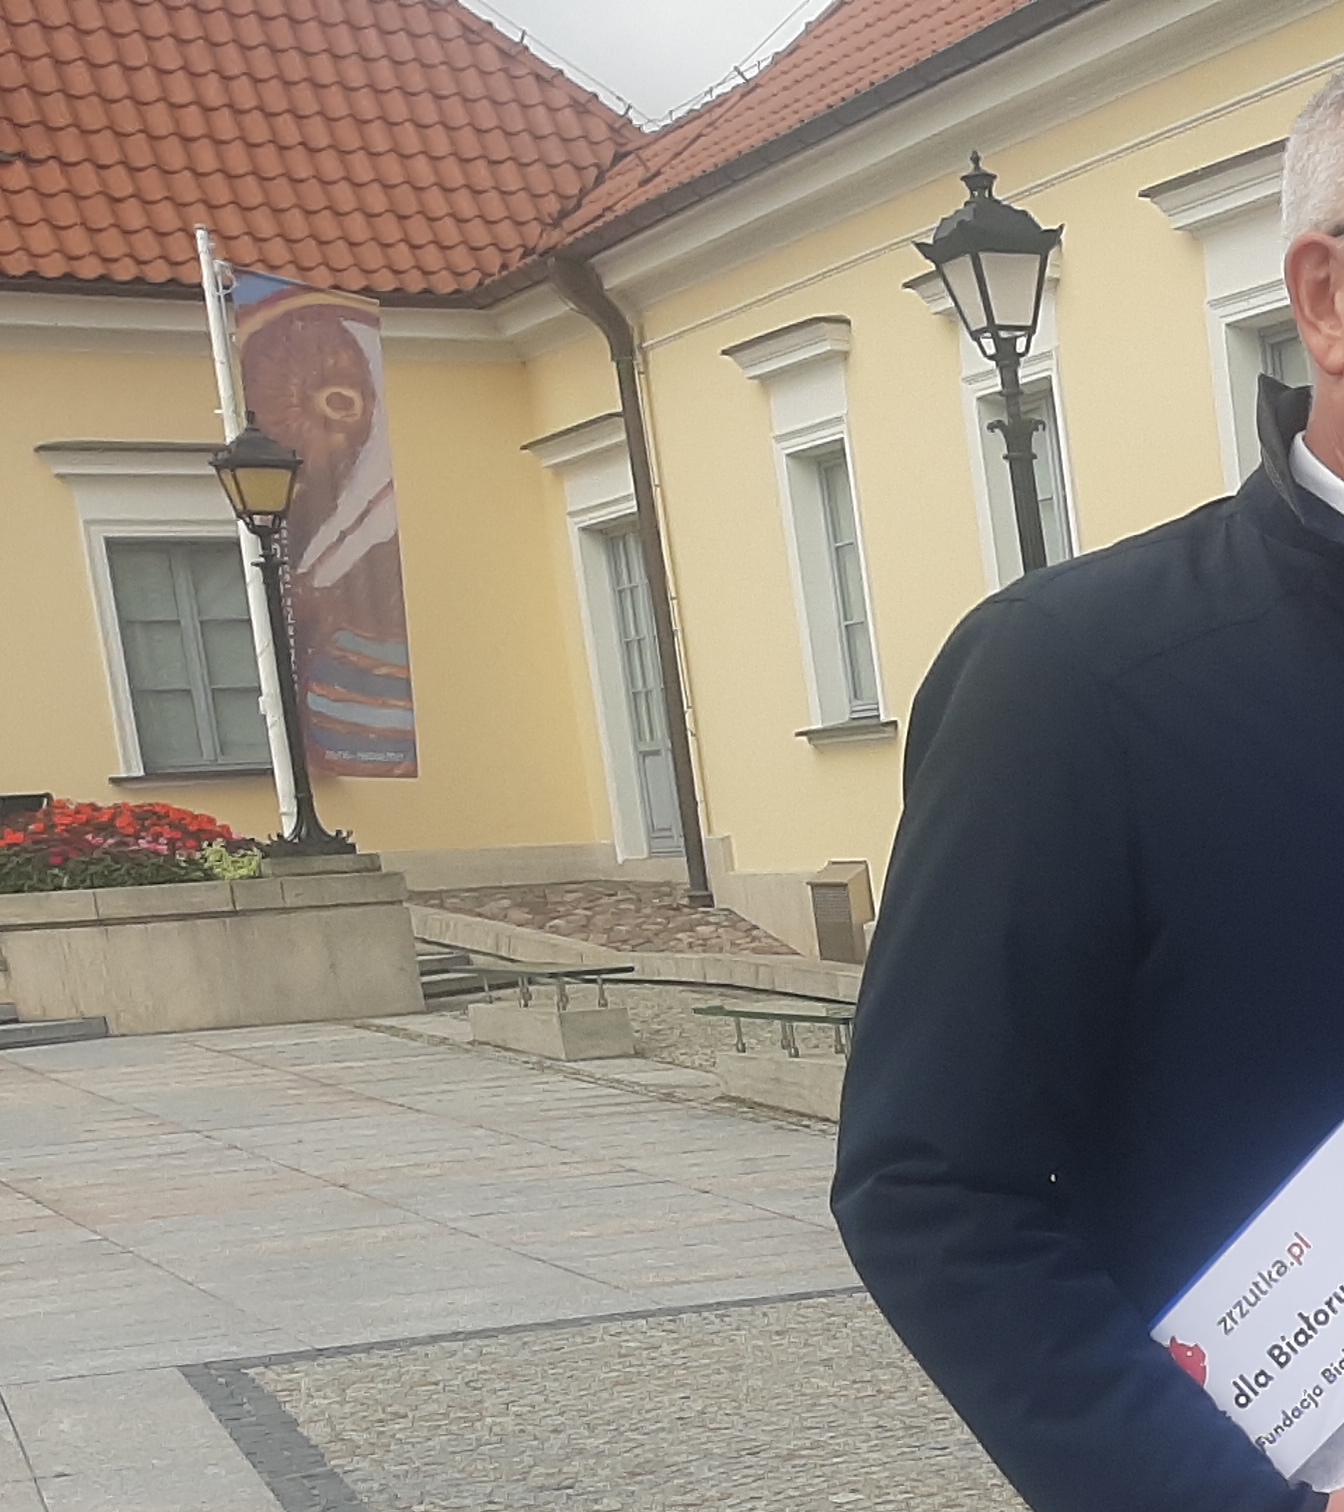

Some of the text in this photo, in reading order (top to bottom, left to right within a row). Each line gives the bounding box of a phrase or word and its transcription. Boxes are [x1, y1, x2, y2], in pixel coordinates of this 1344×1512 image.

[1216, 1231, 1312, 1335] zrzutka.pl
[1232, 1369, 1273, 1409] dla
[1255, 1384, 1323, 1453] Fundacja
